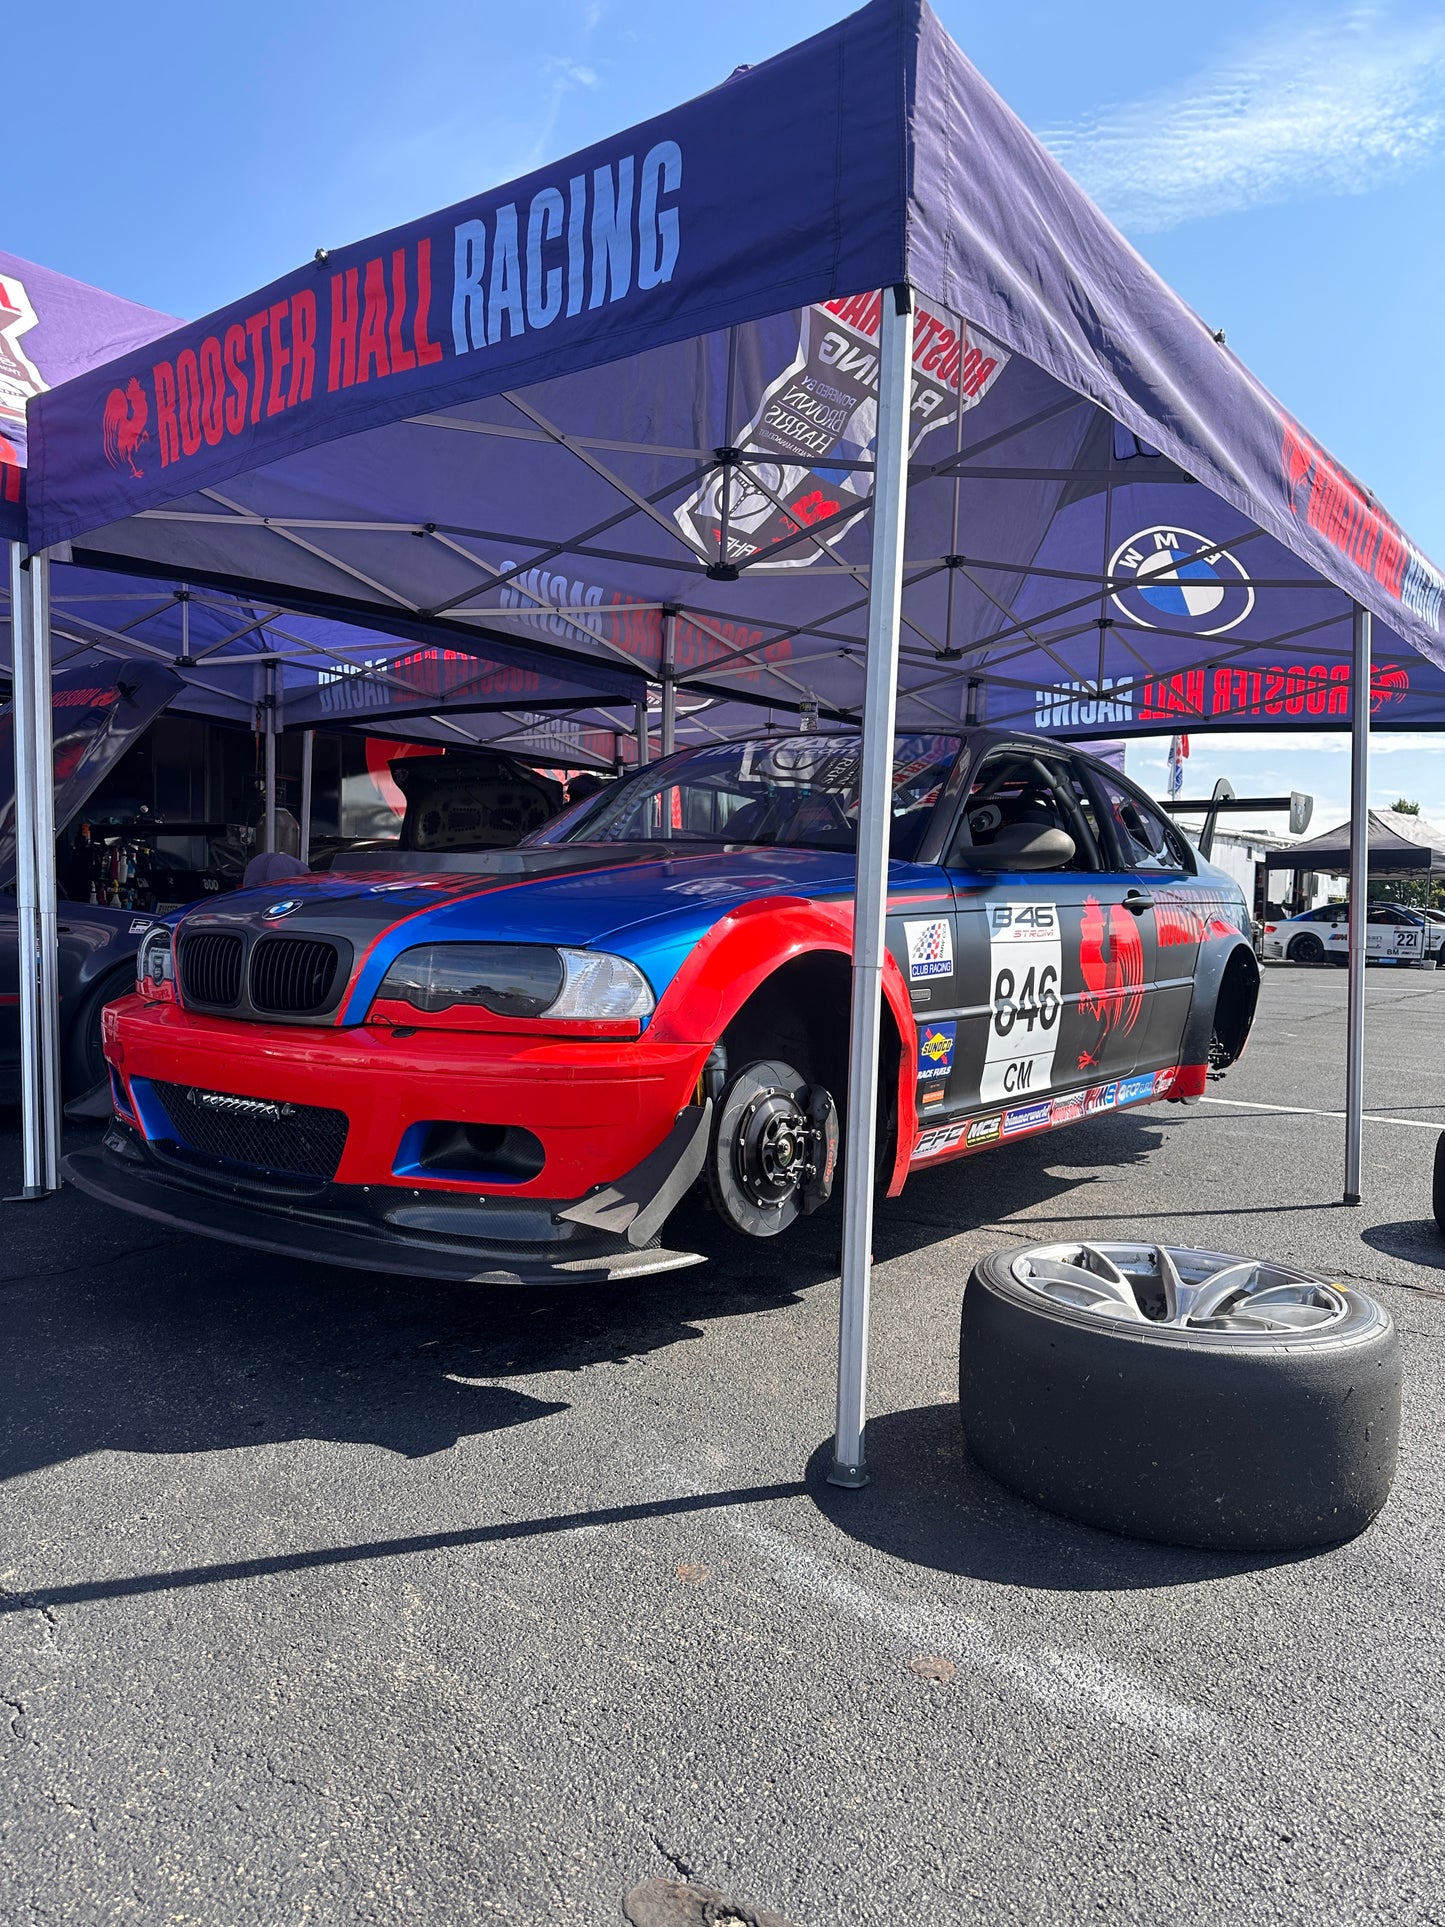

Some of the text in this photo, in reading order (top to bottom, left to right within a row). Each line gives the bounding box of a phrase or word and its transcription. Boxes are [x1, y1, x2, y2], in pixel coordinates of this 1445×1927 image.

[152, 140, 683, 468] ROOSTER HALL RACING
[769, 735, 864, 752] RAC
[992, 906, 1055, 929] B46
[1396, 933, 1418, 947] 221
[1386, 948, 1400, 956] BM
[912, 961, 951, 977] CLUB RACING
[994, 965, 1061, 1037] 846
[923, 1039, 953, 1055] SUNOCO
[917, 1065, 952, 1080] RACE FUELS
[1003, 1060, 1034, 1093] CM
[1125, 1081, 1140, 1098] FCP
[967, 1117, 1001, 1139] MCS
[824, 1138, 836, 1183] brembo
